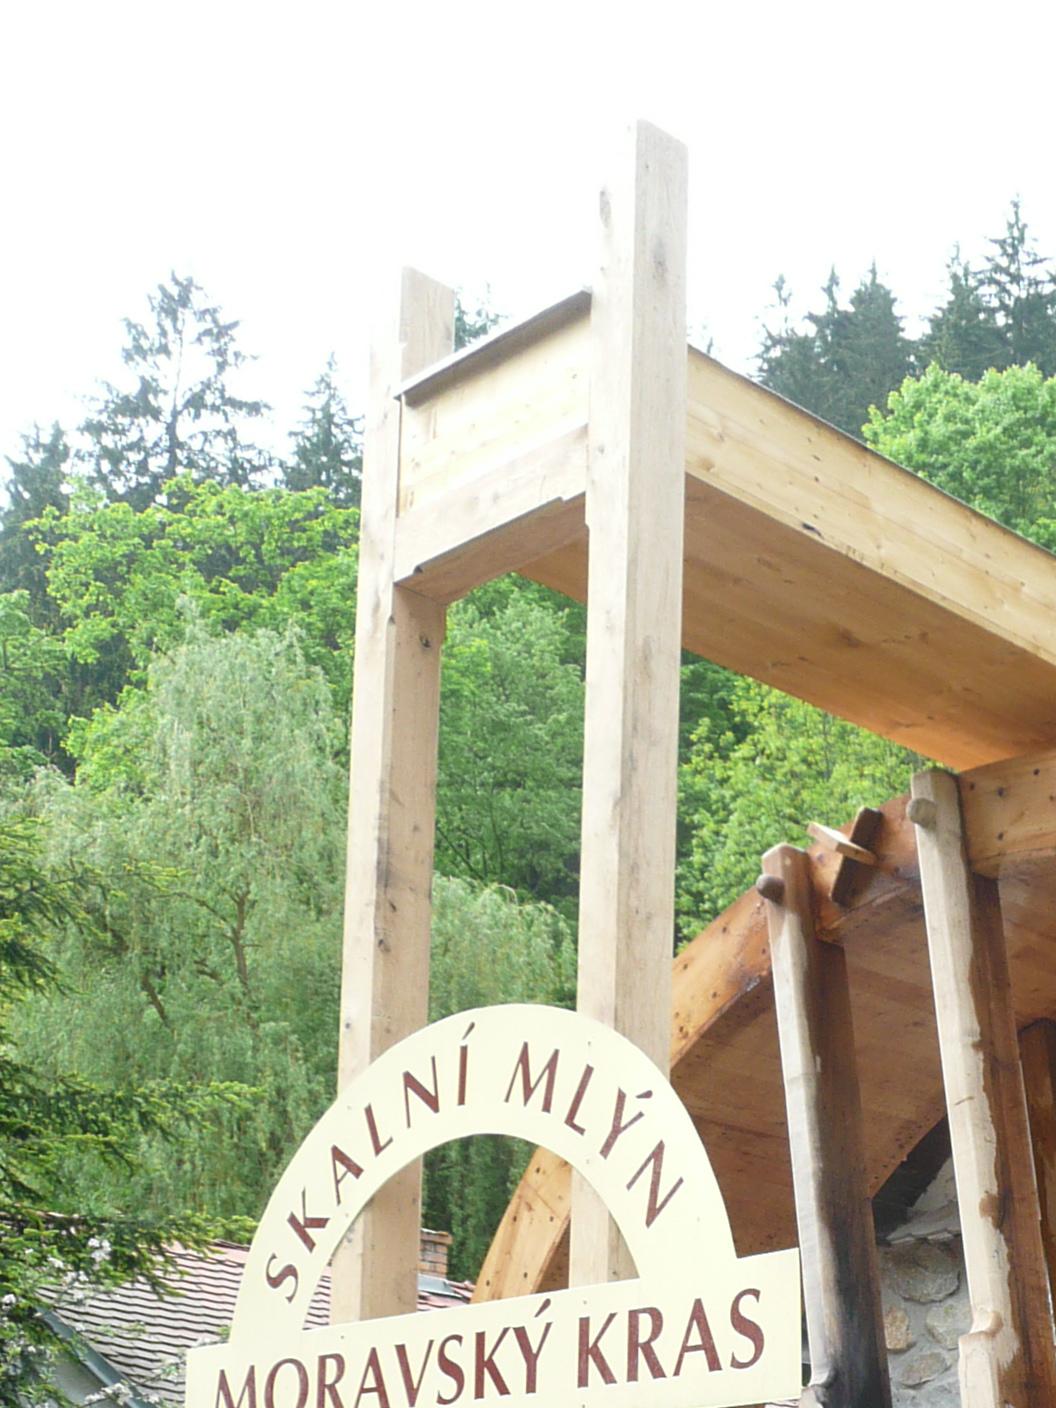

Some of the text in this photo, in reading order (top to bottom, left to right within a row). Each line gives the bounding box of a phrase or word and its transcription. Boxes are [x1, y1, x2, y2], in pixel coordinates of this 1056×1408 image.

[265, 1022, 684, 1303] SKALNÍ MLÝN
[577, 1288, 766, 1389] KRAS
